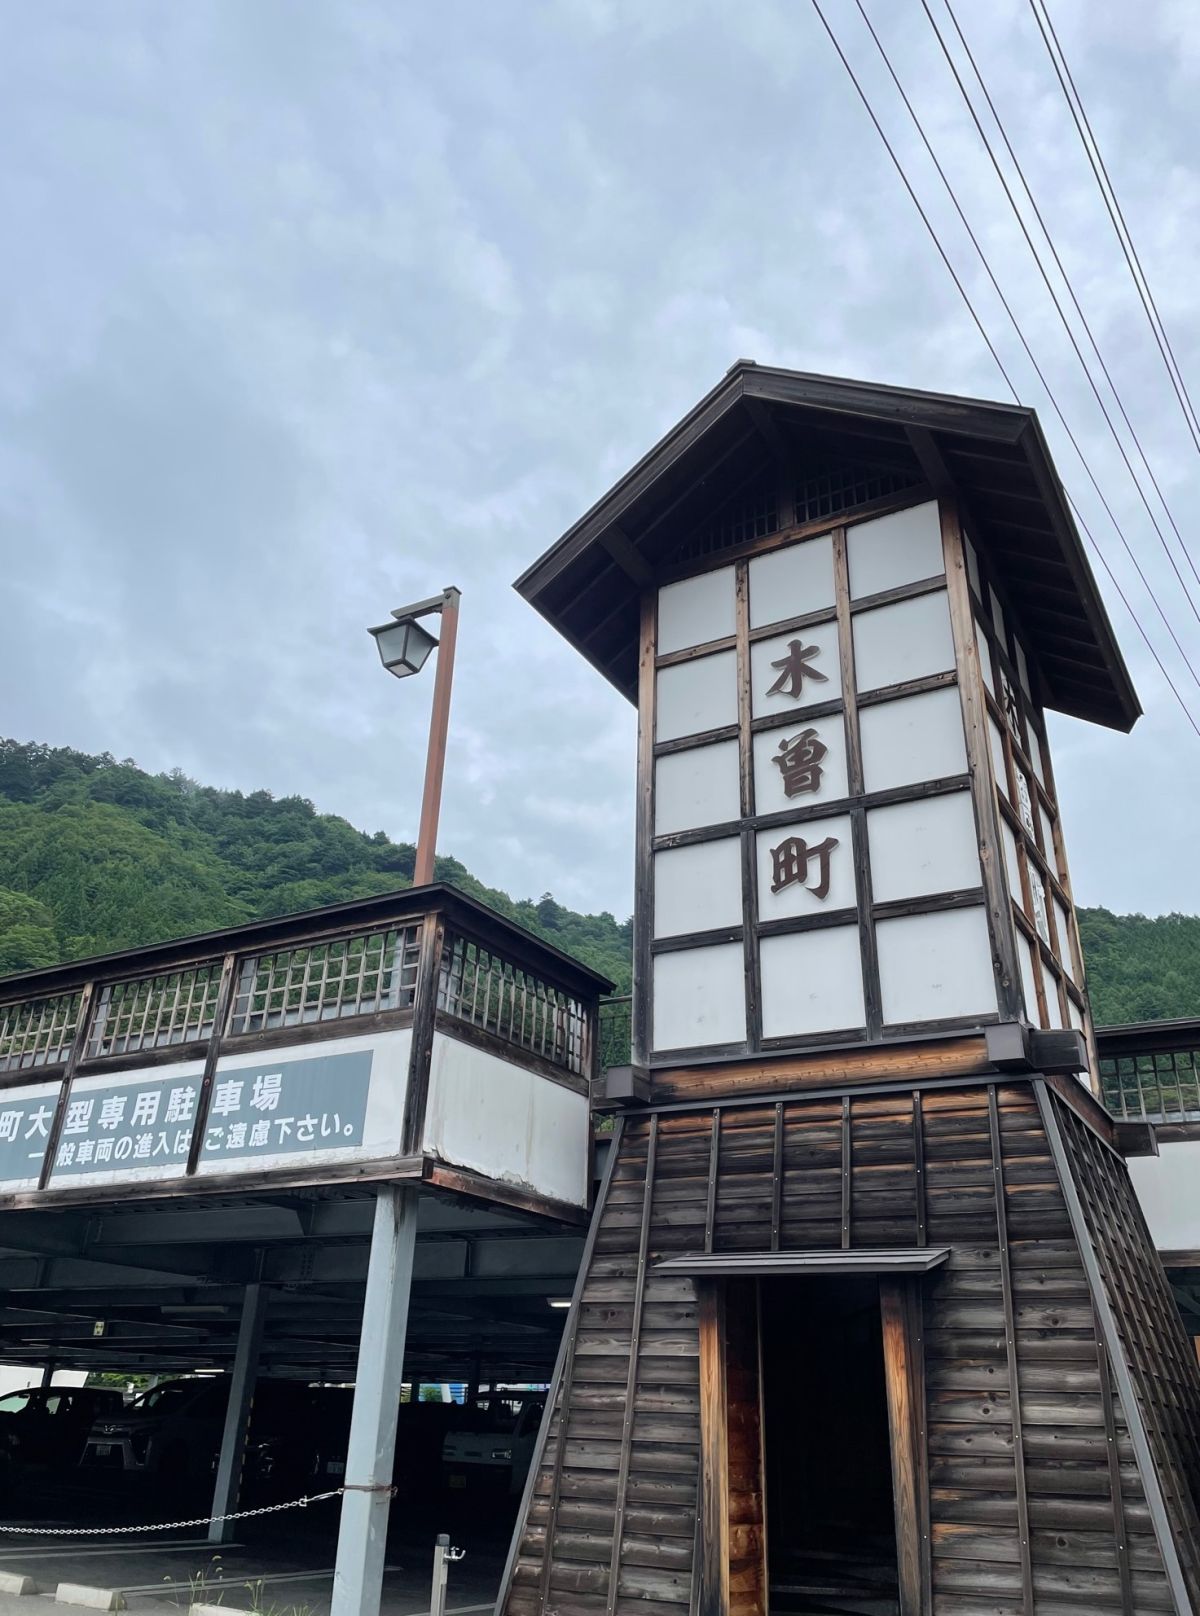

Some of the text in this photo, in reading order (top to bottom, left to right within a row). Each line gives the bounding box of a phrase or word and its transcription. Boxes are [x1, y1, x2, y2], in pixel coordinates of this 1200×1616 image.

[766, 639, 839, 900] 木曽町
[0, 1073, 282, 1142] 町大型専用駐車場
